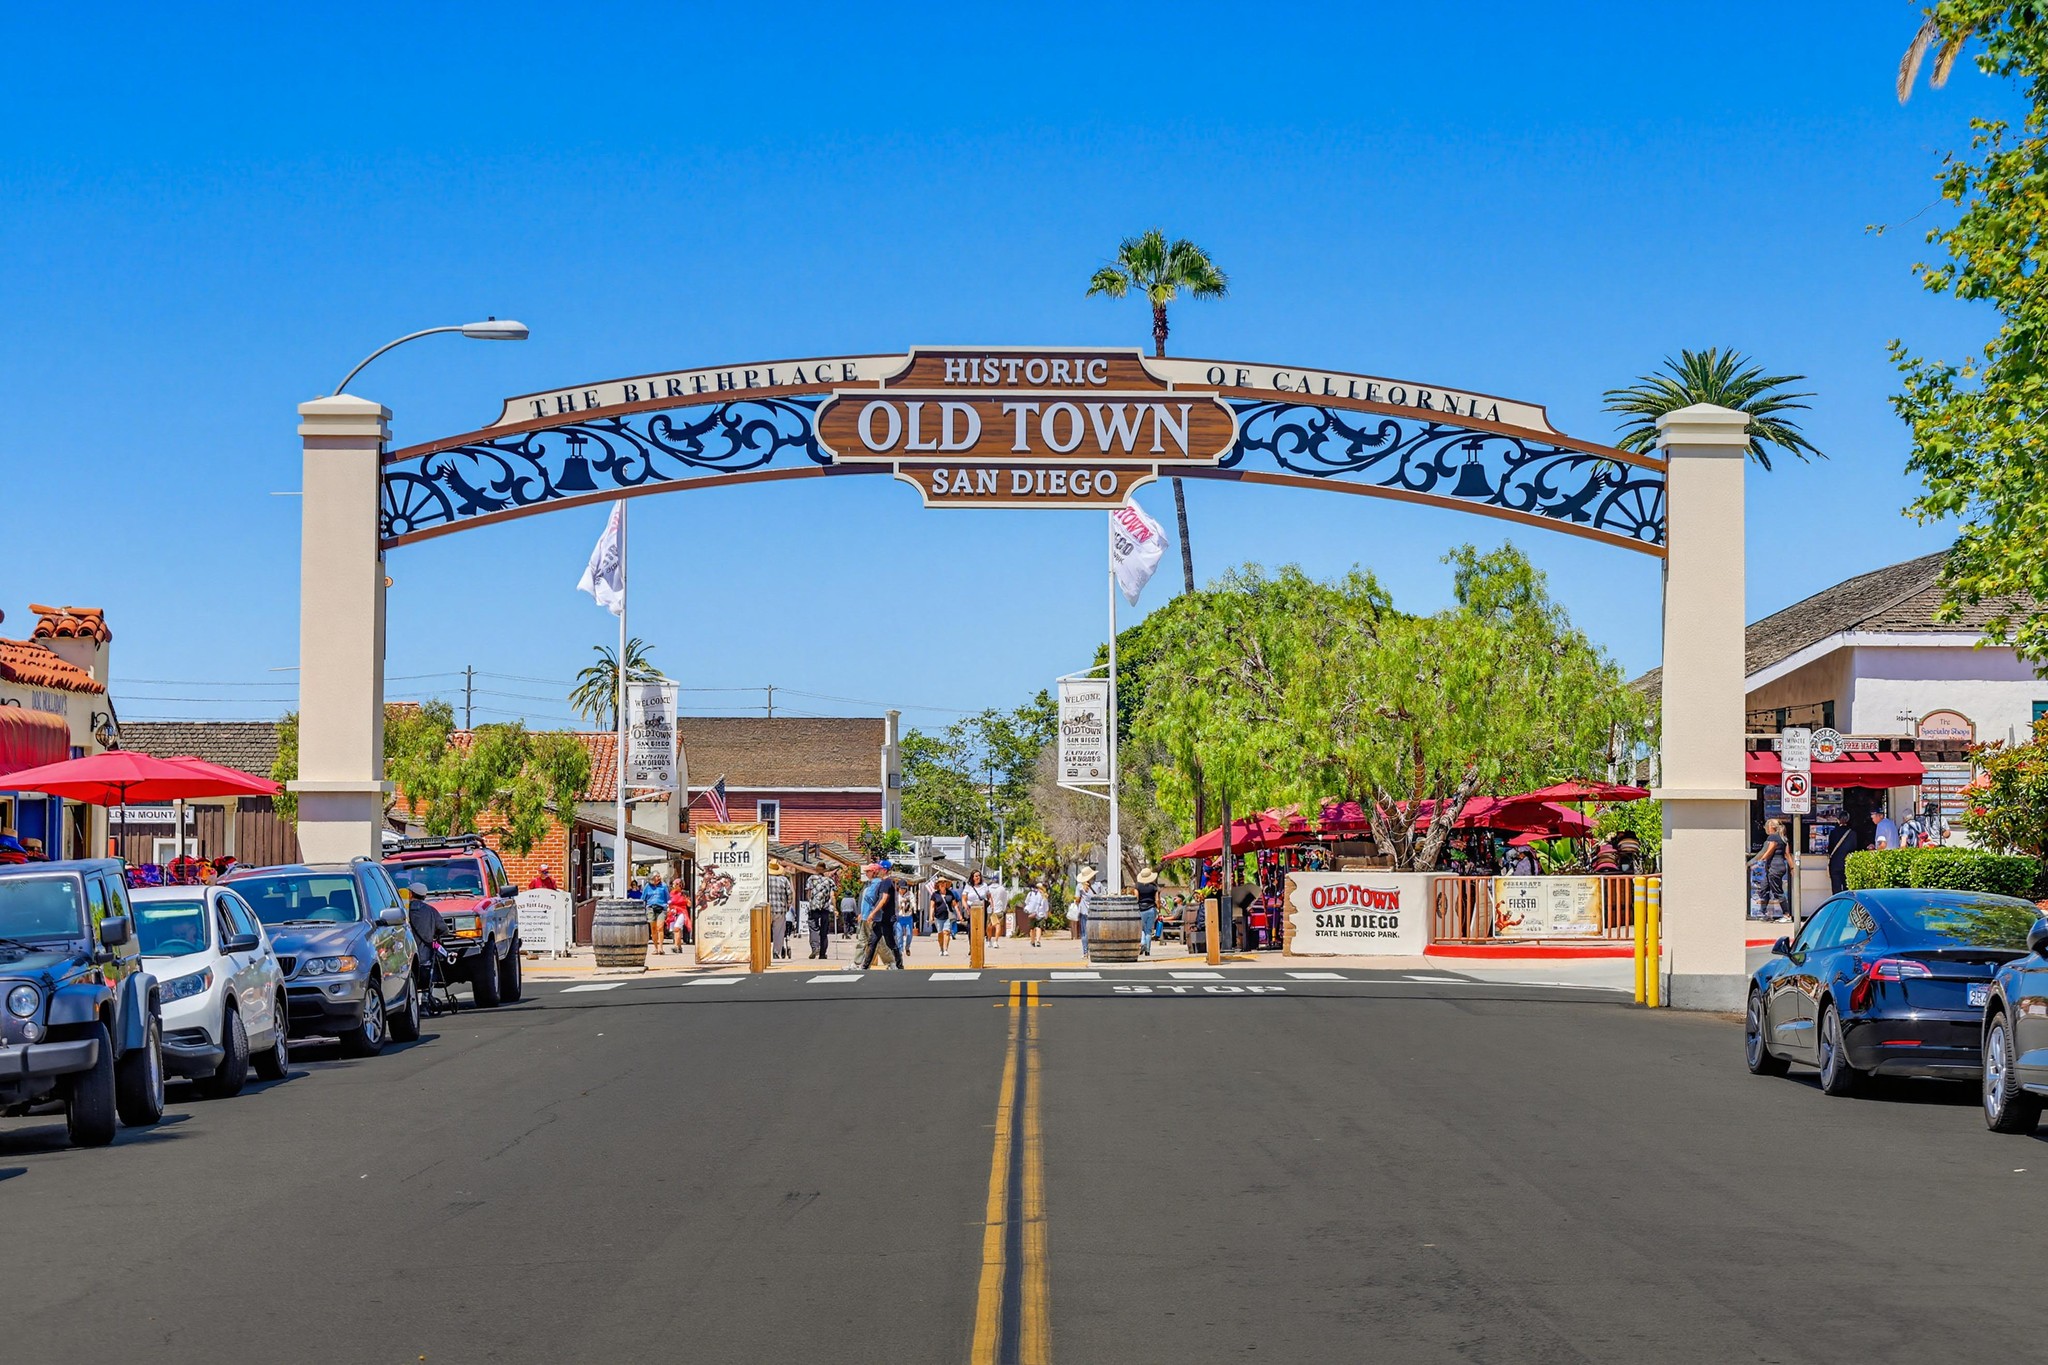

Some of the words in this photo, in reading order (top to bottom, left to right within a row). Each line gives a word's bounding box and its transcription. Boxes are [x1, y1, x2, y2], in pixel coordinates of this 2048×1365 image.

[944, 357, 1108, 385] HISTORIC
[529, 390, 601, 418] THE
[623, 362, 859, 402] BIRTHPLACE
[1206, 366, 1250, 388] OF
[1273, 371, 1502, 422] CALIFORNIA
[857, 400, 982, 453] OLD
[1002, 401, 1193, 457] TOWN
[932, 469, 999, 495] SAN
[1011, 469, 1118, 495] DIEGO
[635, 697, 671, 707] WELCOME
[1065, 693, 1101, 703] WELCOME
[1951, 727, 1970, 736] Shops
[109, 811, 135, 819] LDEN
[138, 811, 189, 819] MOUNTN
[713, 851, 750, 864] FIESTA
[1509, 898, 1537, 909] FIESTA
[1316, 914, 1346, 928] SAN
[1351, 914, 1399, 929] DIEGO
[1340, 930, 1376, 938] HISTORIC
[1112, 985, 1286, 993] STOP
